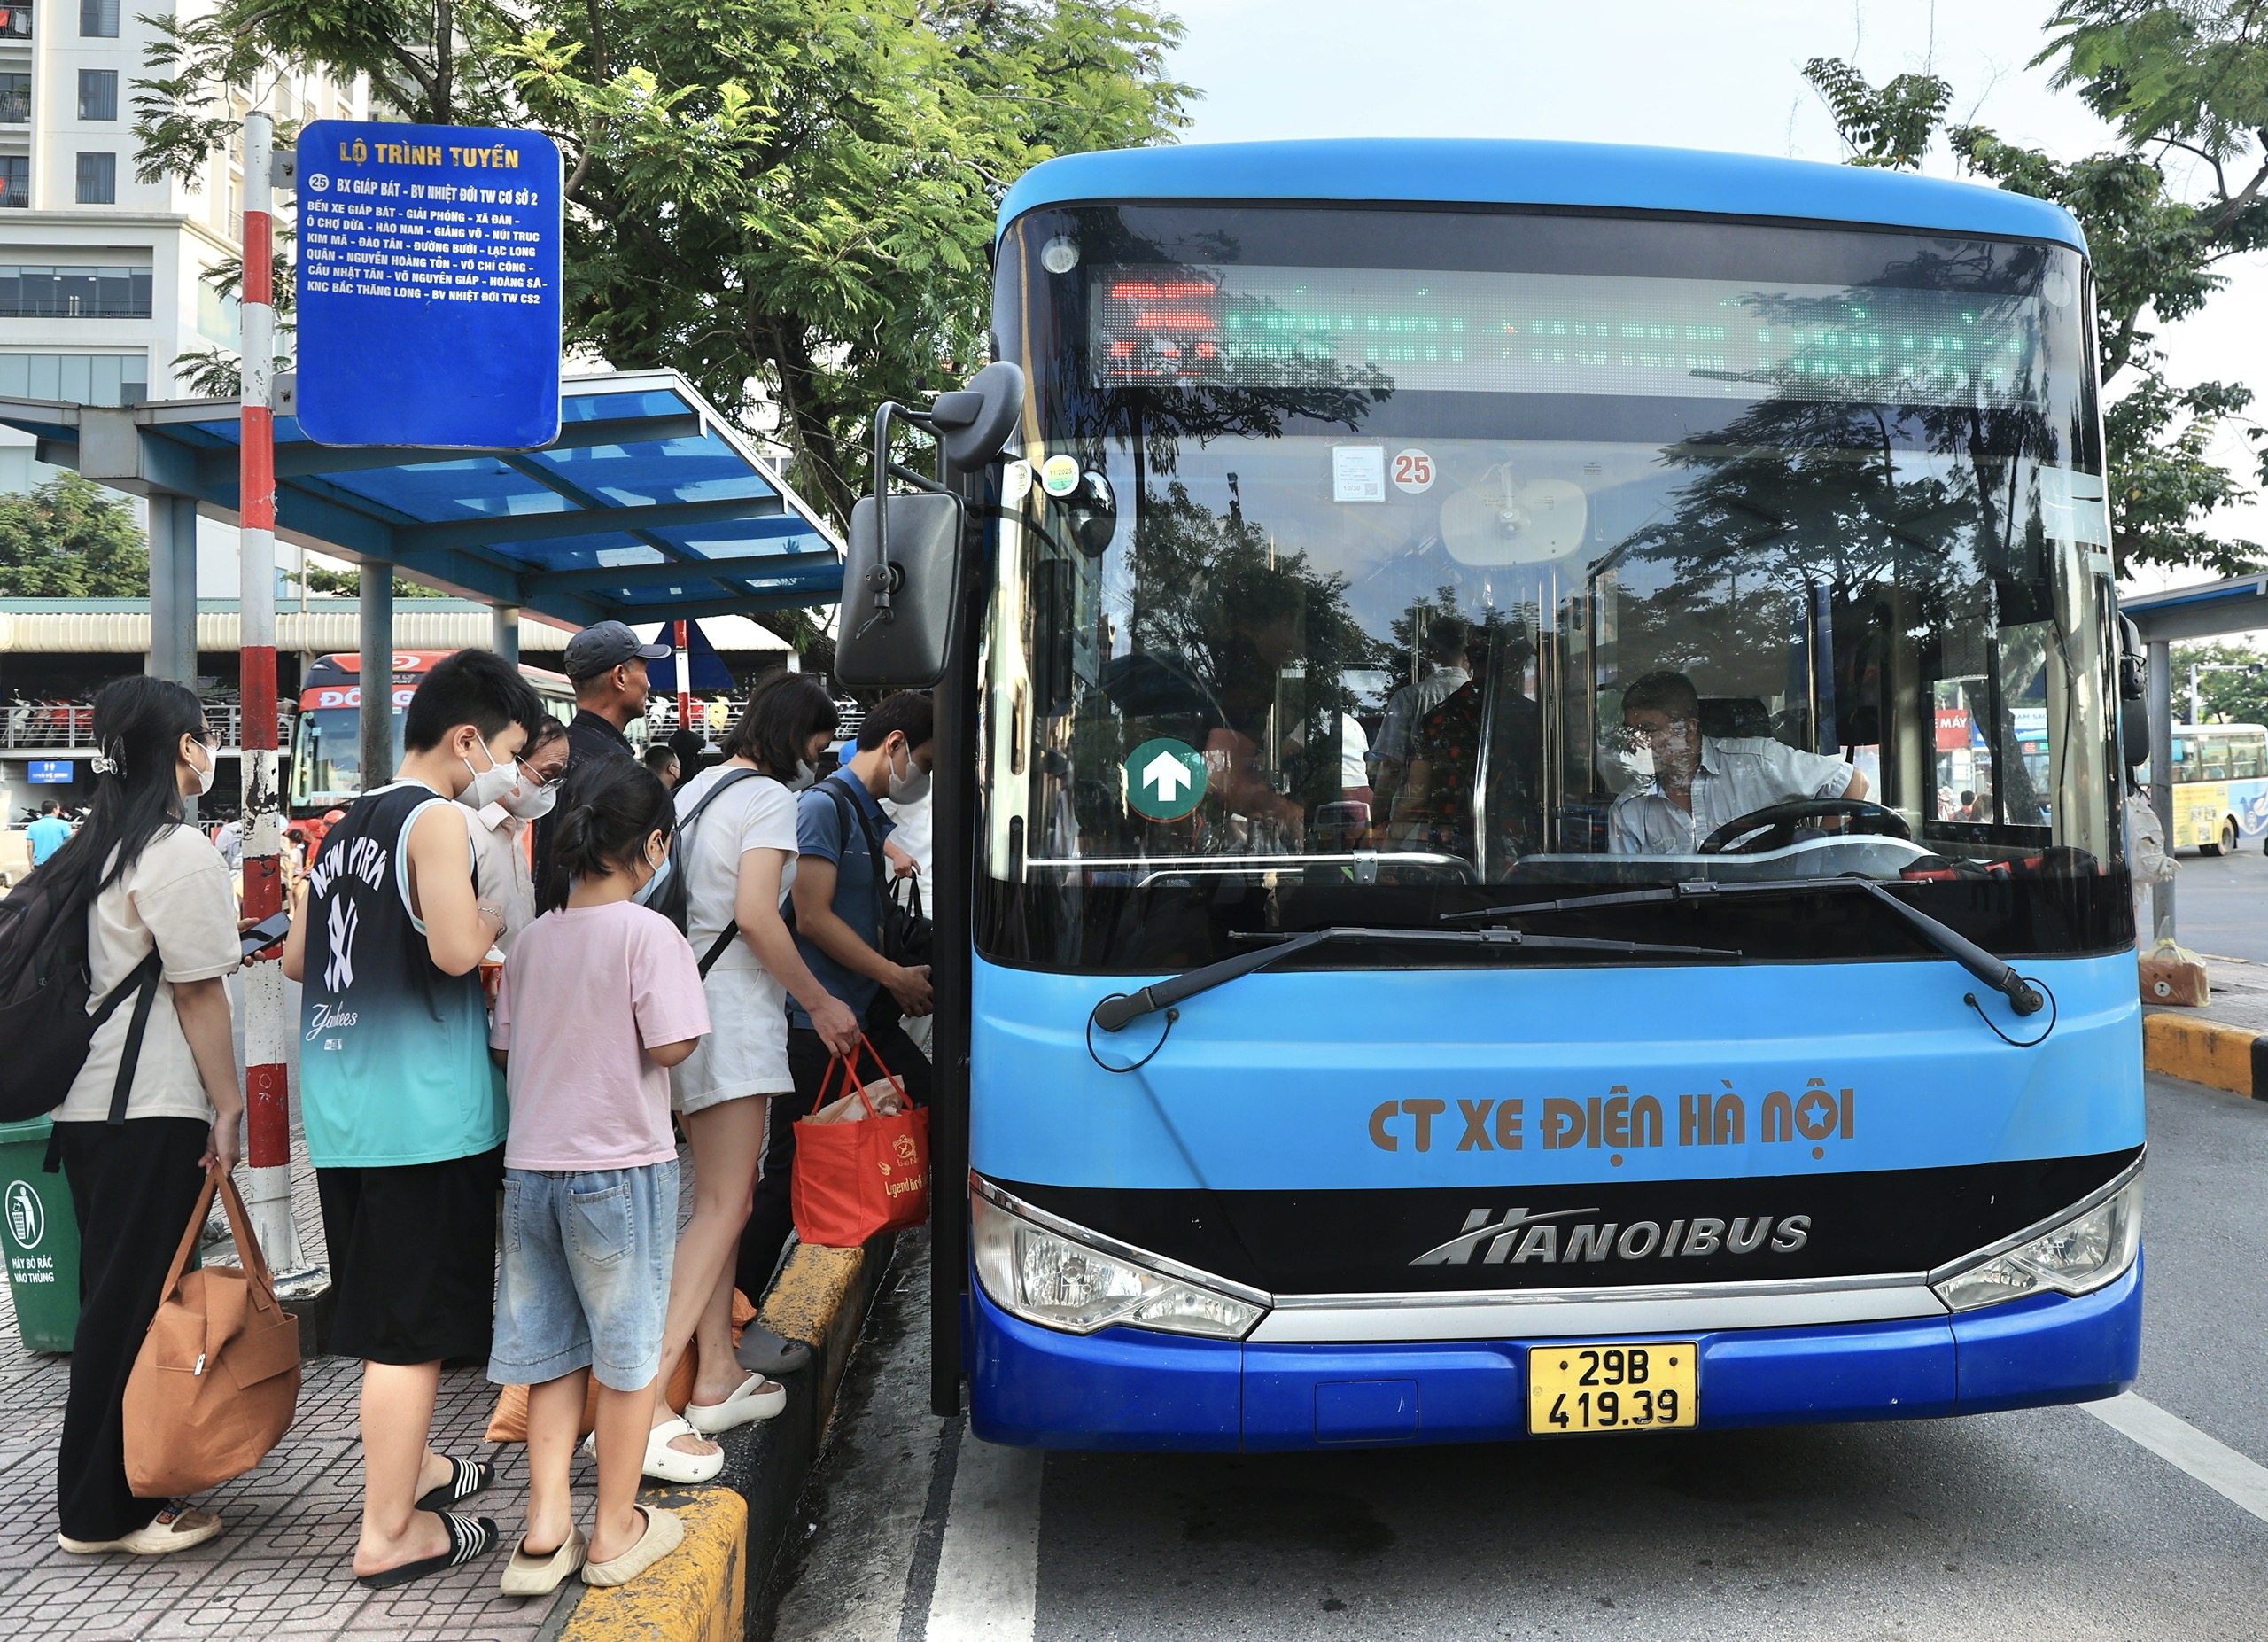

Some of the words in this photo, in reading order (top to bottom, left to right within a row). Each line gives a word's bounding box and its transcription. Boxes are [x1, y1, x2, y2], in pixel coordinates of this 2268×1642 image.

[339, 138, 368, 167] LỘ
[374, 140, 442, 166] TRÌNH
[449, 144, 519, 168] TUYẾN
[311, 176, 327, 188] 25
[337, 178, 352, 193] BX
[353, 177, 378, 195] GIÁP
[380, 180, 401, 197] BÁT
[410, 184, 425, 198] BV
[427, 183, 458, 204] NHIỆT
[459, 185, 478, 202] ĐỚI
[479, 189, 496, 204] TW
[498, 189, 513, 205] CƠ
[515, 188, 529, 206] SỞ
[531, 192, 538, 206] 2
[307, 198, 329, 212] BẾN
[331, 203, 345, 214] XE
[347, 204, 373, 215] GIÁP
[376, 206, 396, 217] BÁT
[430, 209, 465, 222] PHÓNG
[475, 212, 489, 223] XÃ
[491, 213, 512, 225] ĐÀN
[307, 214, 315, 227] Ô
[317, 217, 340, 231] CHỢ
[343, 218, 365, 230] DỪA
[376, 221, 397, 233] HÀO
[400, 224, 423, 235] NAM
[468, 227, 483, 238] VÕ
[492, 229, 510, 241] NÚI
[307, 232, 328, 244] KIM
[330, 234, 347, 245] MÃ
[358, 236, 380, 248] ĐÀO
[383, 237, 403, 249] TÂN
[413, 240, 449, 253] ĐƯỜNG
[487, 245, 507, 258] LẠC
[509, 246, 536, 257] LONG
[307, 247, 336, 261] QUÂN
[391, 254, 427, 268] HOÀNG
[430, 255, 450, 268] TÔN
[460, 259, 475, 270] VÕ
[477, 260, 495, 271] CHÍ
[498, 260, 526, 272] CÔNG
[333, 266, 361, 279] NHẬT
[363, 268, 384, 280] TÂN
[394, 270, 408, 281] VÕ
[411, 271, 452, 284] NGUYÊN
[455, 274, 479, 285] GIÁP
[490, 276, 524, 287] HOÀNG
[307, 280, 329, 292] KNC
[356, 284, 391, 297] THĂNG
[393, 287, 422, 299] LONG
[431, 289, 446, 300] BV
[448, 289, 479, 302] NHIỆT
[481, 290, 500, 302] ĐỚI
[501, 292, 517, 303] TW
[520, 293, 540, 304] CS2
[1395, 455, 1431, 484] 25
[1940, 715, 1967, 728] MÁY
[1368, 1098, 1446, 1152] CT
[1456, 1098, 1524, 1151] XE
[1540, 1085, 1663, 1168] ĐIỆN
[1680, 1079, 1745, 1145] HÀ
[1761, 1078, 1854, 1160] NỘI
[1408, 1207, 1812, 1265] HANOIBUS
[12, 1256, 25, 1269] HÃY
[36, 1254, 53, 1268] RÁC
[13, 1270, 27, 1283] VÀO
[27, 1270, 54, 1283] THÙNG
[1579, 1349, 1649, 1386] 29B
[1548, 1389, 1678, 1428] 419.39
